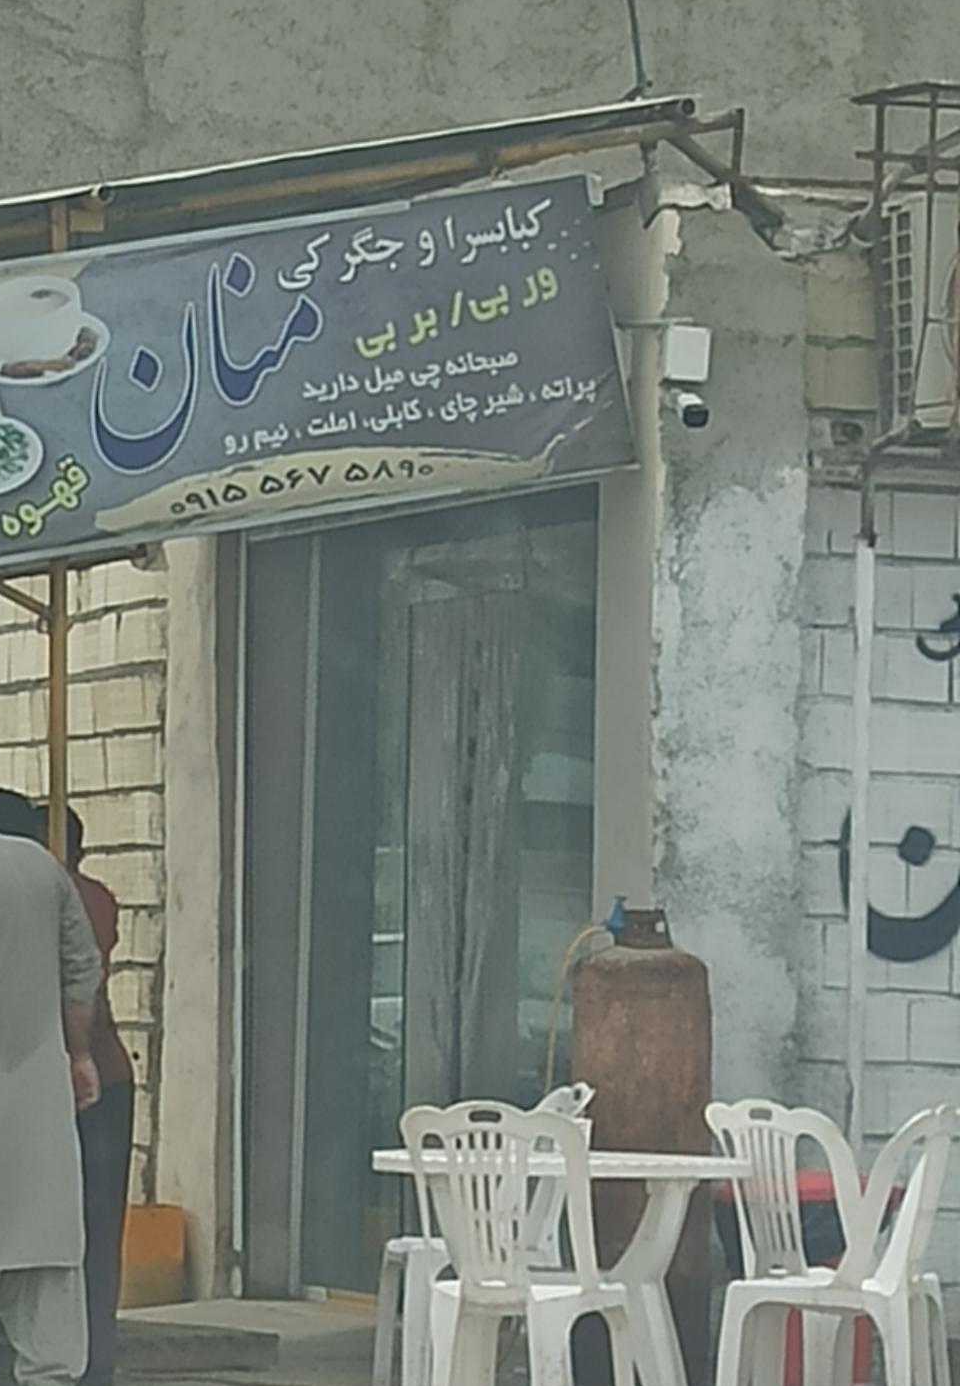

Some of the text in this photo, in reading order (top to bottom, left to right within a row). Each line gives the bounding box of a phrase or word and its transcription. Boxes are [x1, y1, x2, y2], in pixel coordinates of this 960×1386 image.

[418, 228, 436, 266] و
[444, 198, 552, 263] کبابسرا
[91, 252, 324, 475] منان
[301, 351, 520, 402] صبحانه چی میل دارید
[482, 382, 525, 417] شیر
[169, 459, 435, 516] ۰۹۱۵ ۵۶۷ ۵۸۹۰
